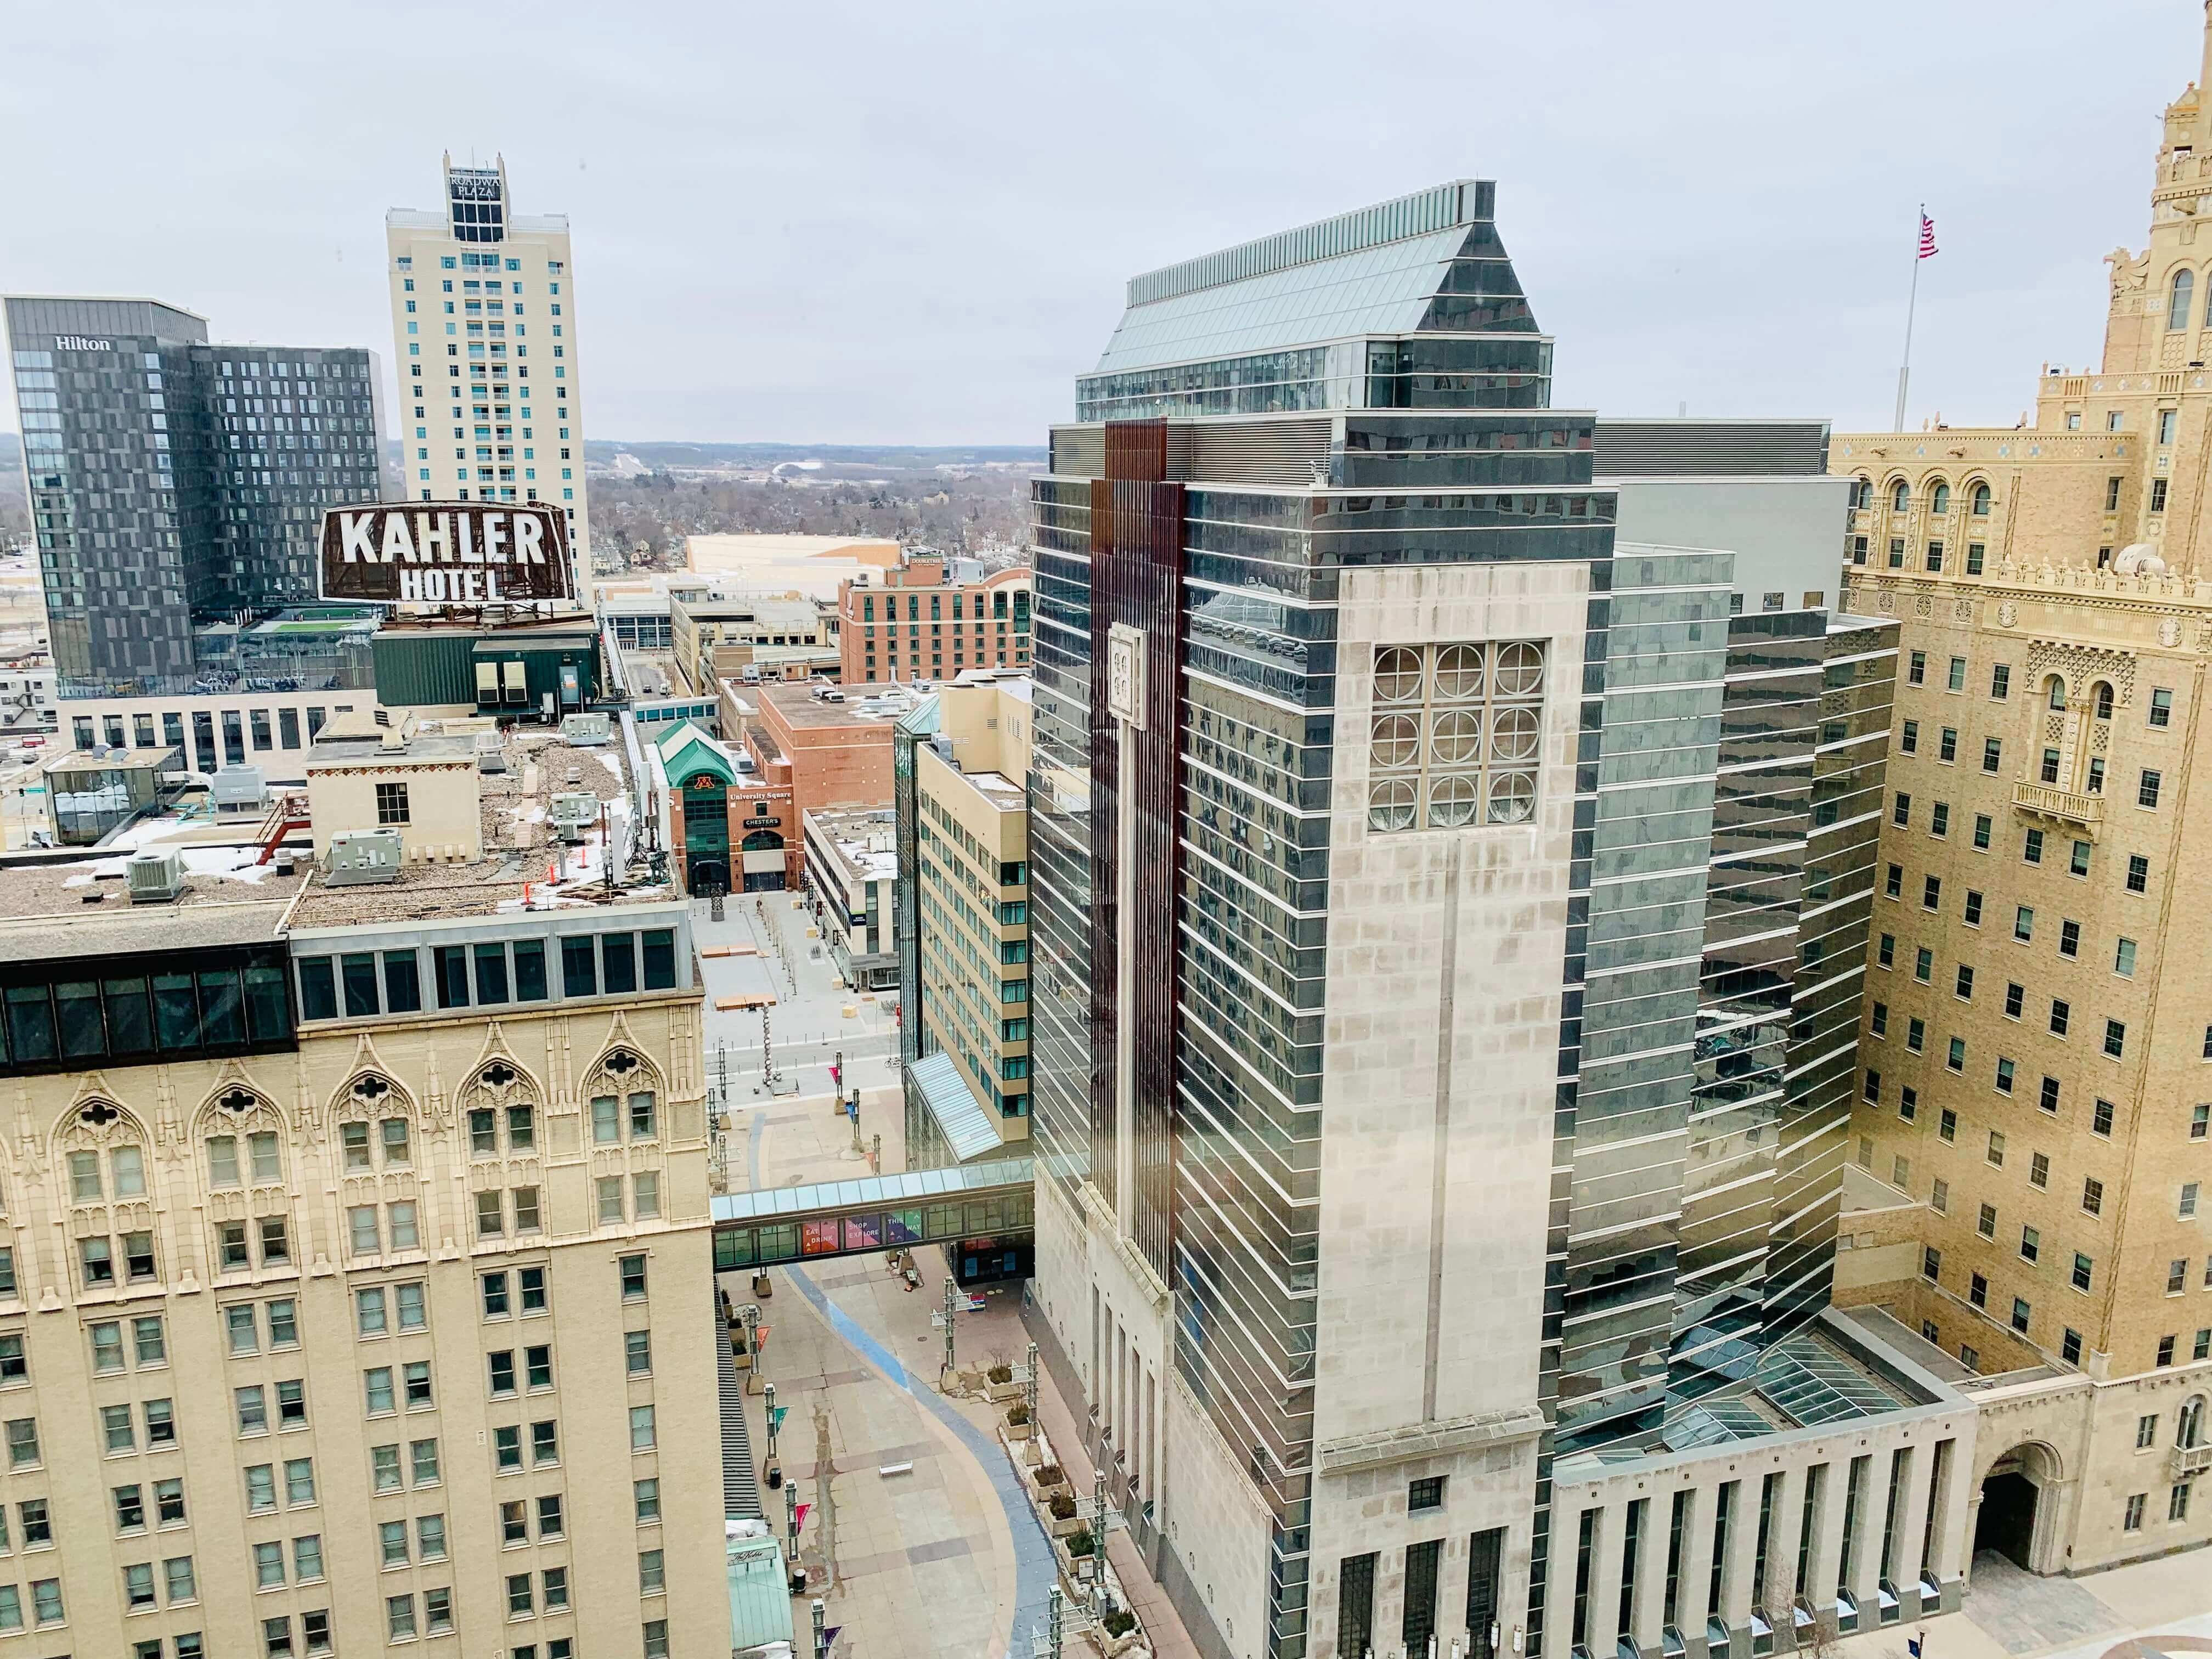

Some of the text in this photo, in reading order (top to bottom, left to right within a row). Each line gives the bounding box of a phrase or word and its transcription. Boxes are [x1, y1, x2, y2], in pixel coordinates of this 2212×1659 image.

[458, 186, 494, 196] PLAZA
[55, 336, 111, 351] Hilton
[340, 512, 546, 564] KAHLER
[399, 568, 506, 602] HOTEL
[811, 1235, 833, 1244] DRINK
[849, 1229, 879, 1238] EXPLORE
